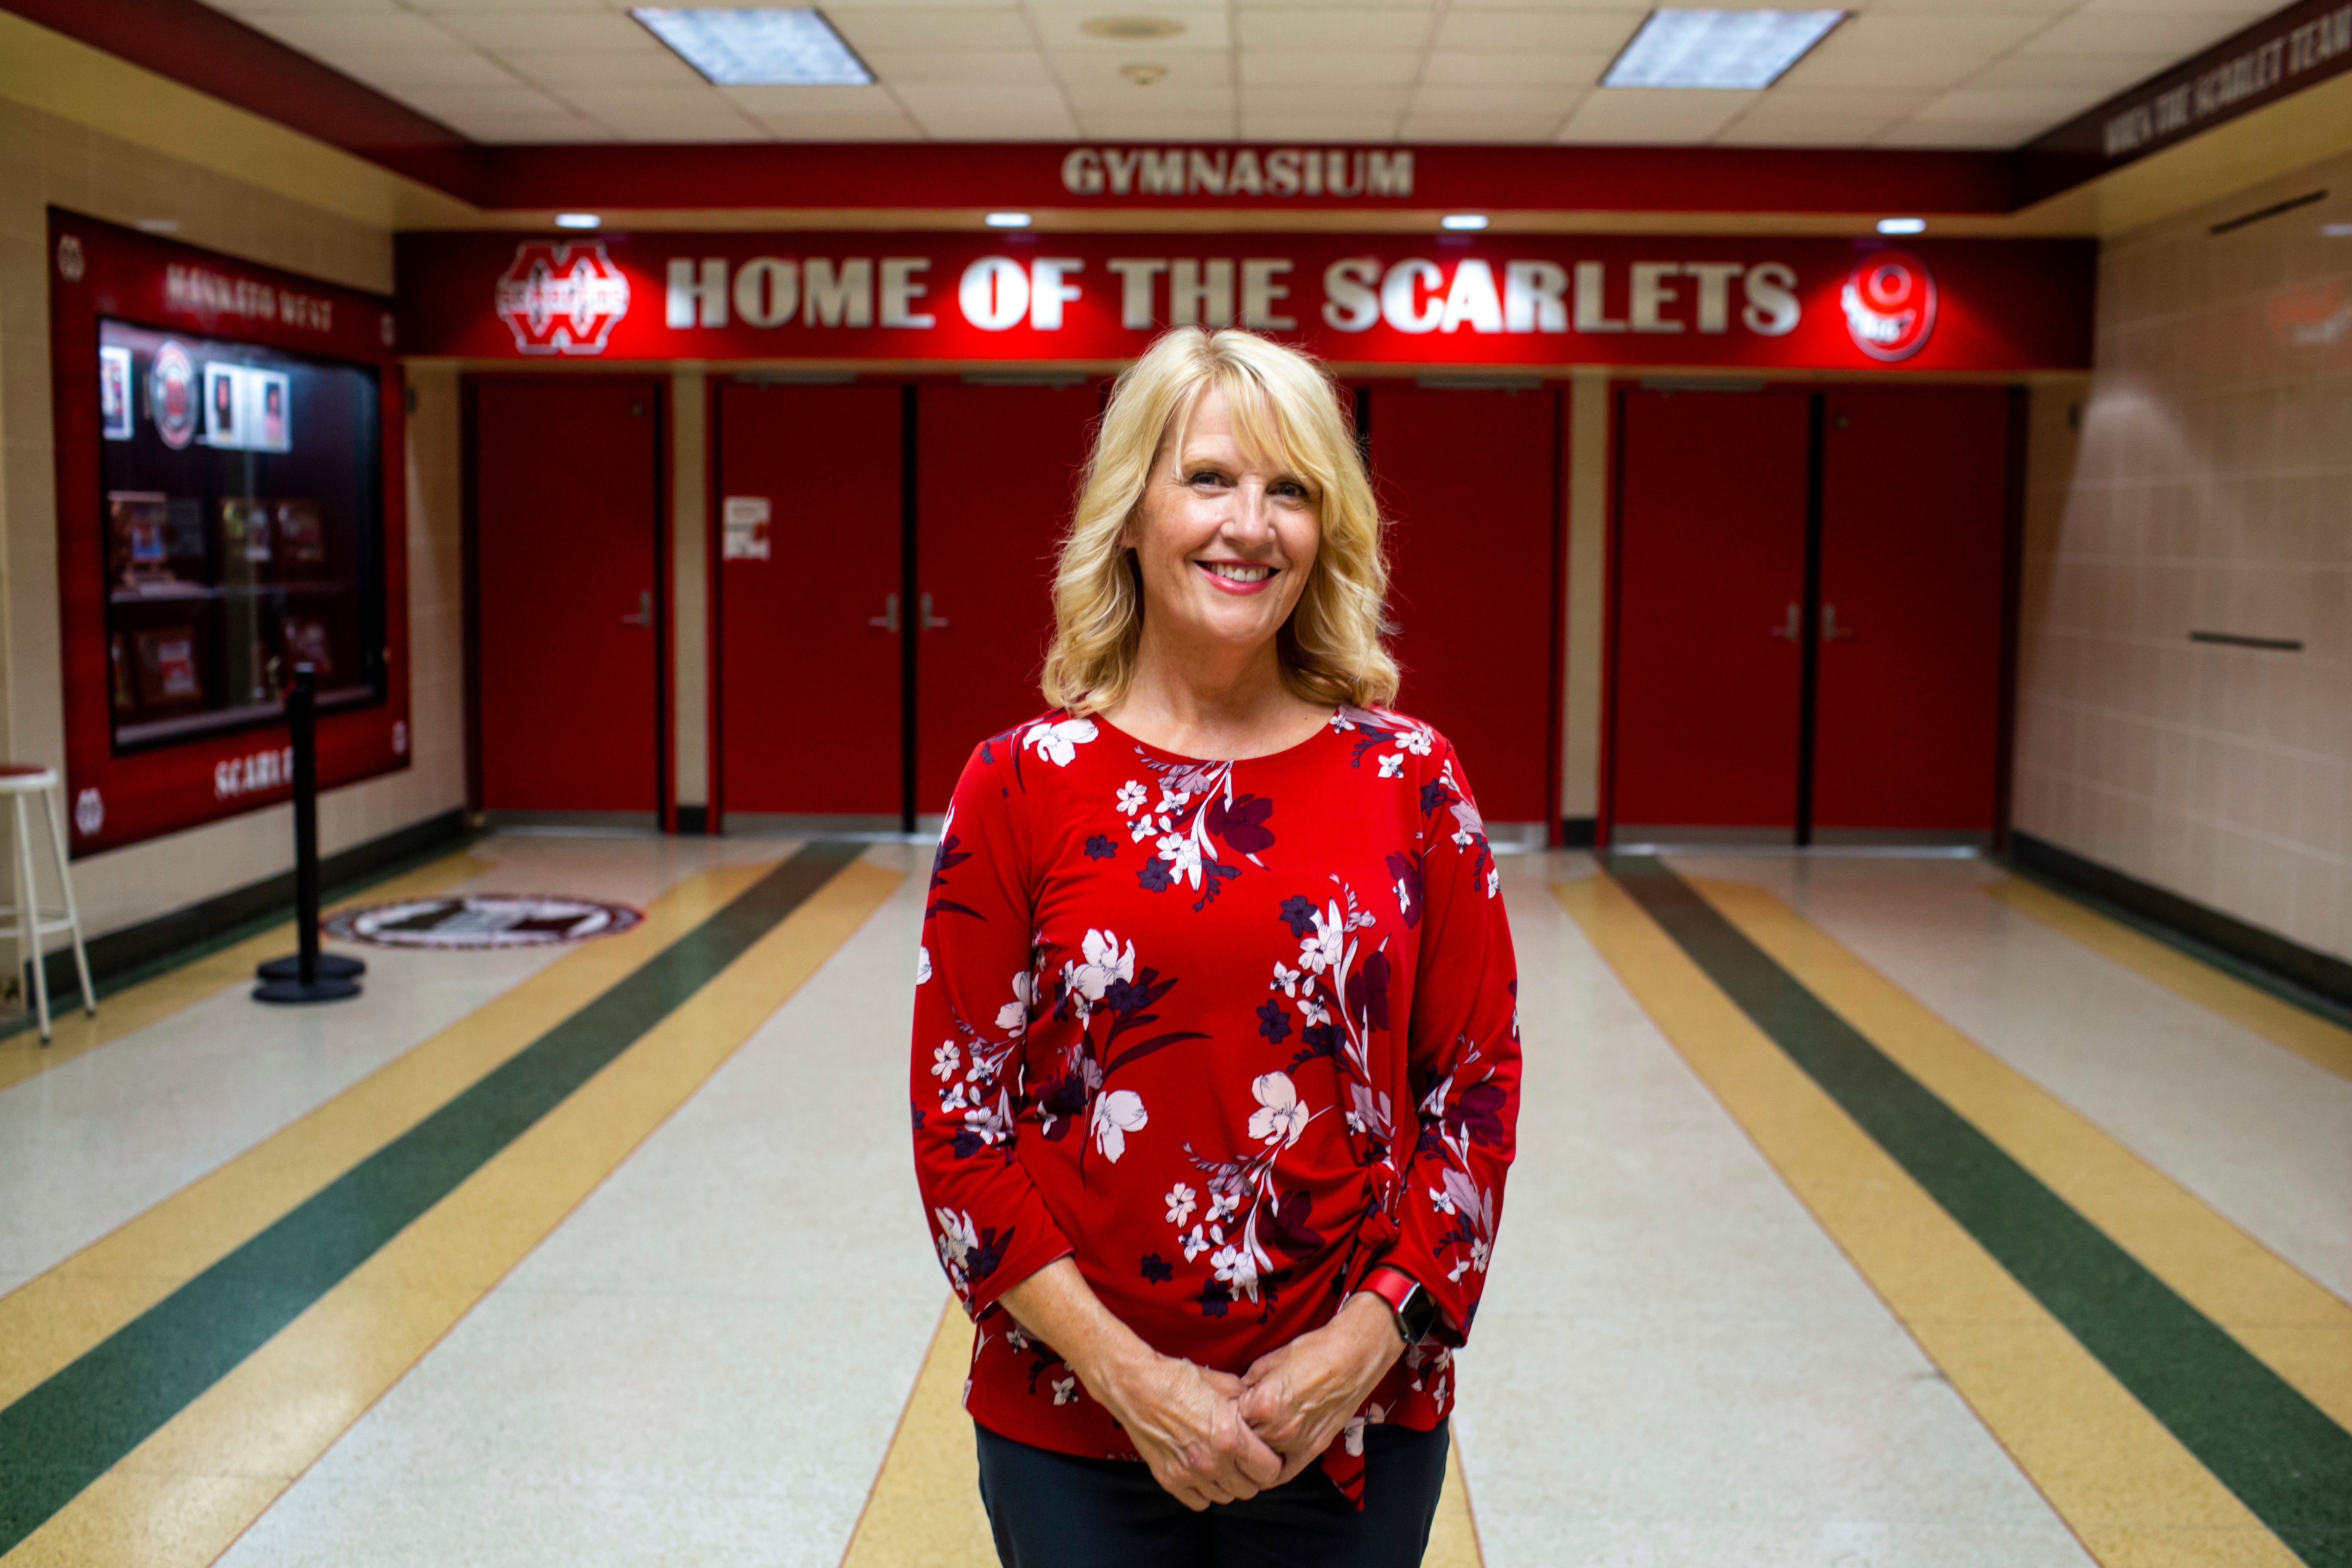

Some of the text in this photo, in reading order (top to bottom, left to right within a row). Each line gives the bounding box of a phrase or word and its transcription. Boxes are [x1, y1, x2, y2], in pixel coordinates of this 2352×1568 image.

[2155, 83, 2190, 135] THE
[1061, 149, 1414, 197] GYMNASIUM
[665, 257, 936, 330] HOME
[958, 255, 1085, 331] OF
[1106, 258, 1298, 331] THE
[1321, 257, 1801, 337] SCARLETS
